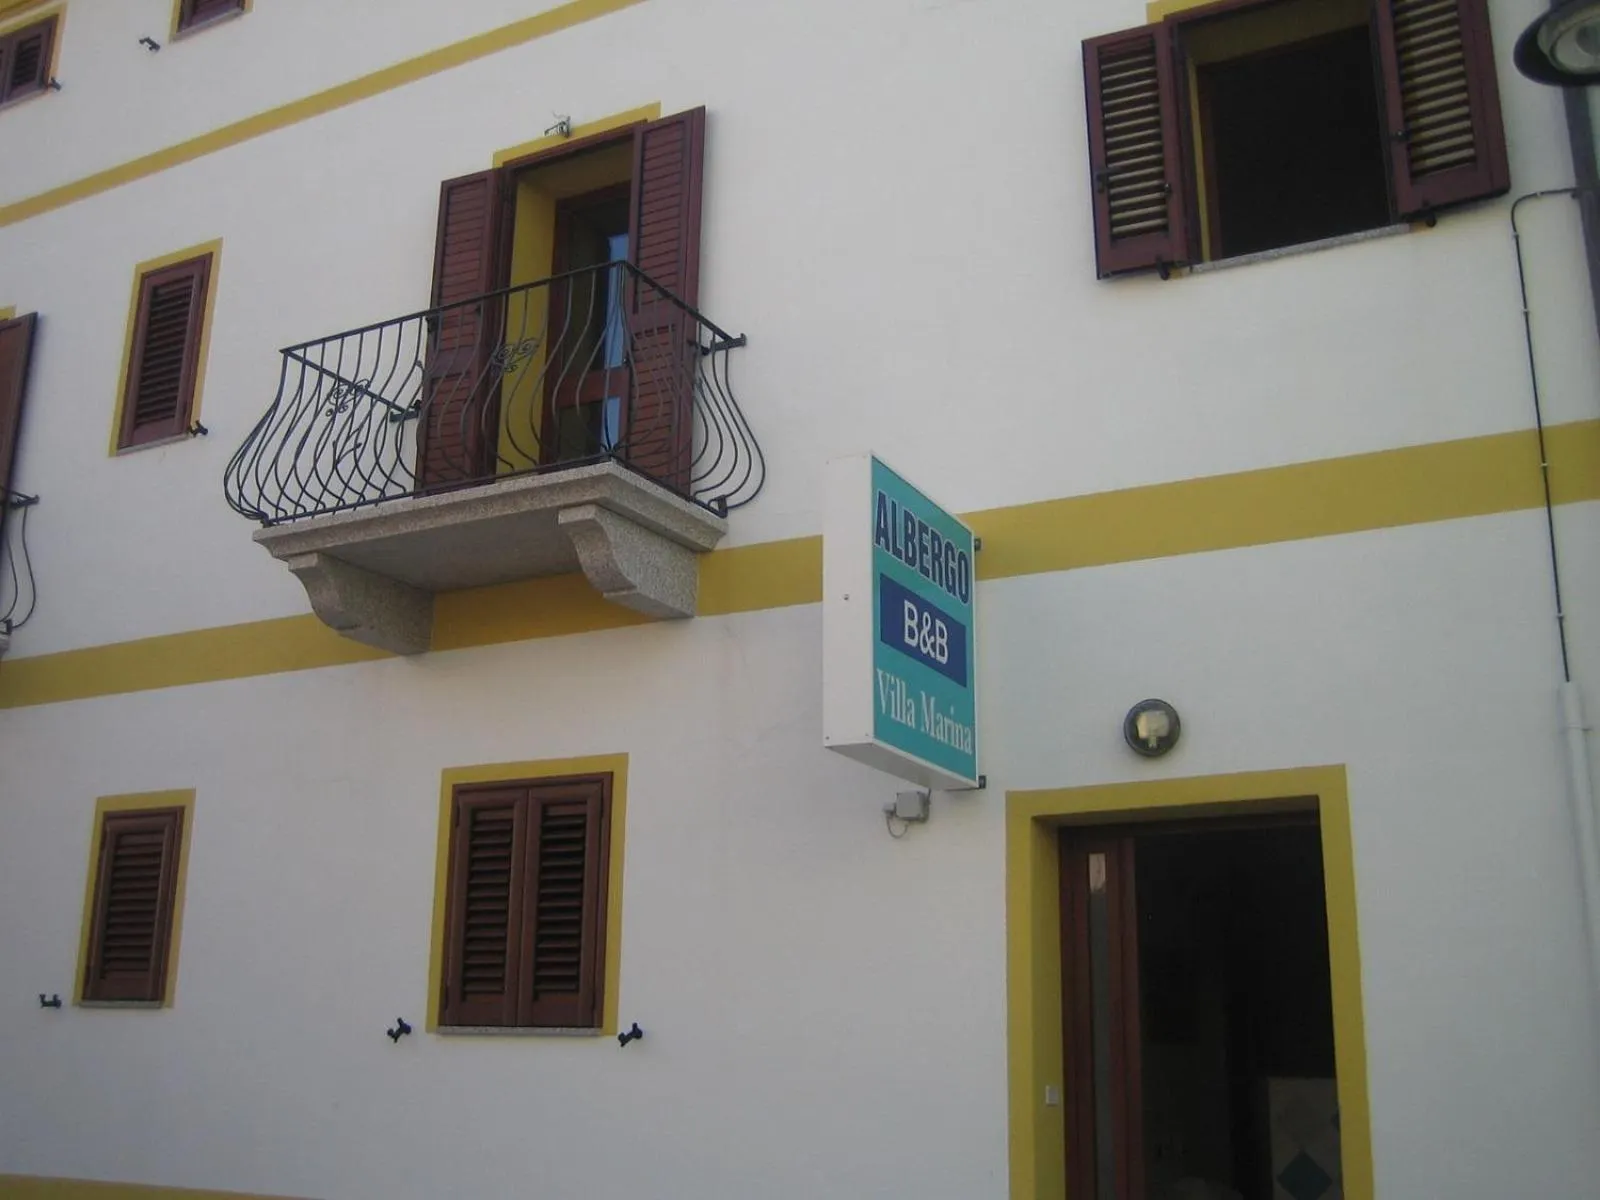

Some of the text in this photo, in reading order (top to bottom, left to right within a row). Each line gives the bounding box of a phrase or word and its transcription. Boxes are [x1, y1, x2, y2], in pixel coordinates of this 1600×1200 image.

[874, 490, 970, 605] ALBERGO
[903, 599, 949, 665] B&B
[876, 668, 973, 756] Villa Marina
